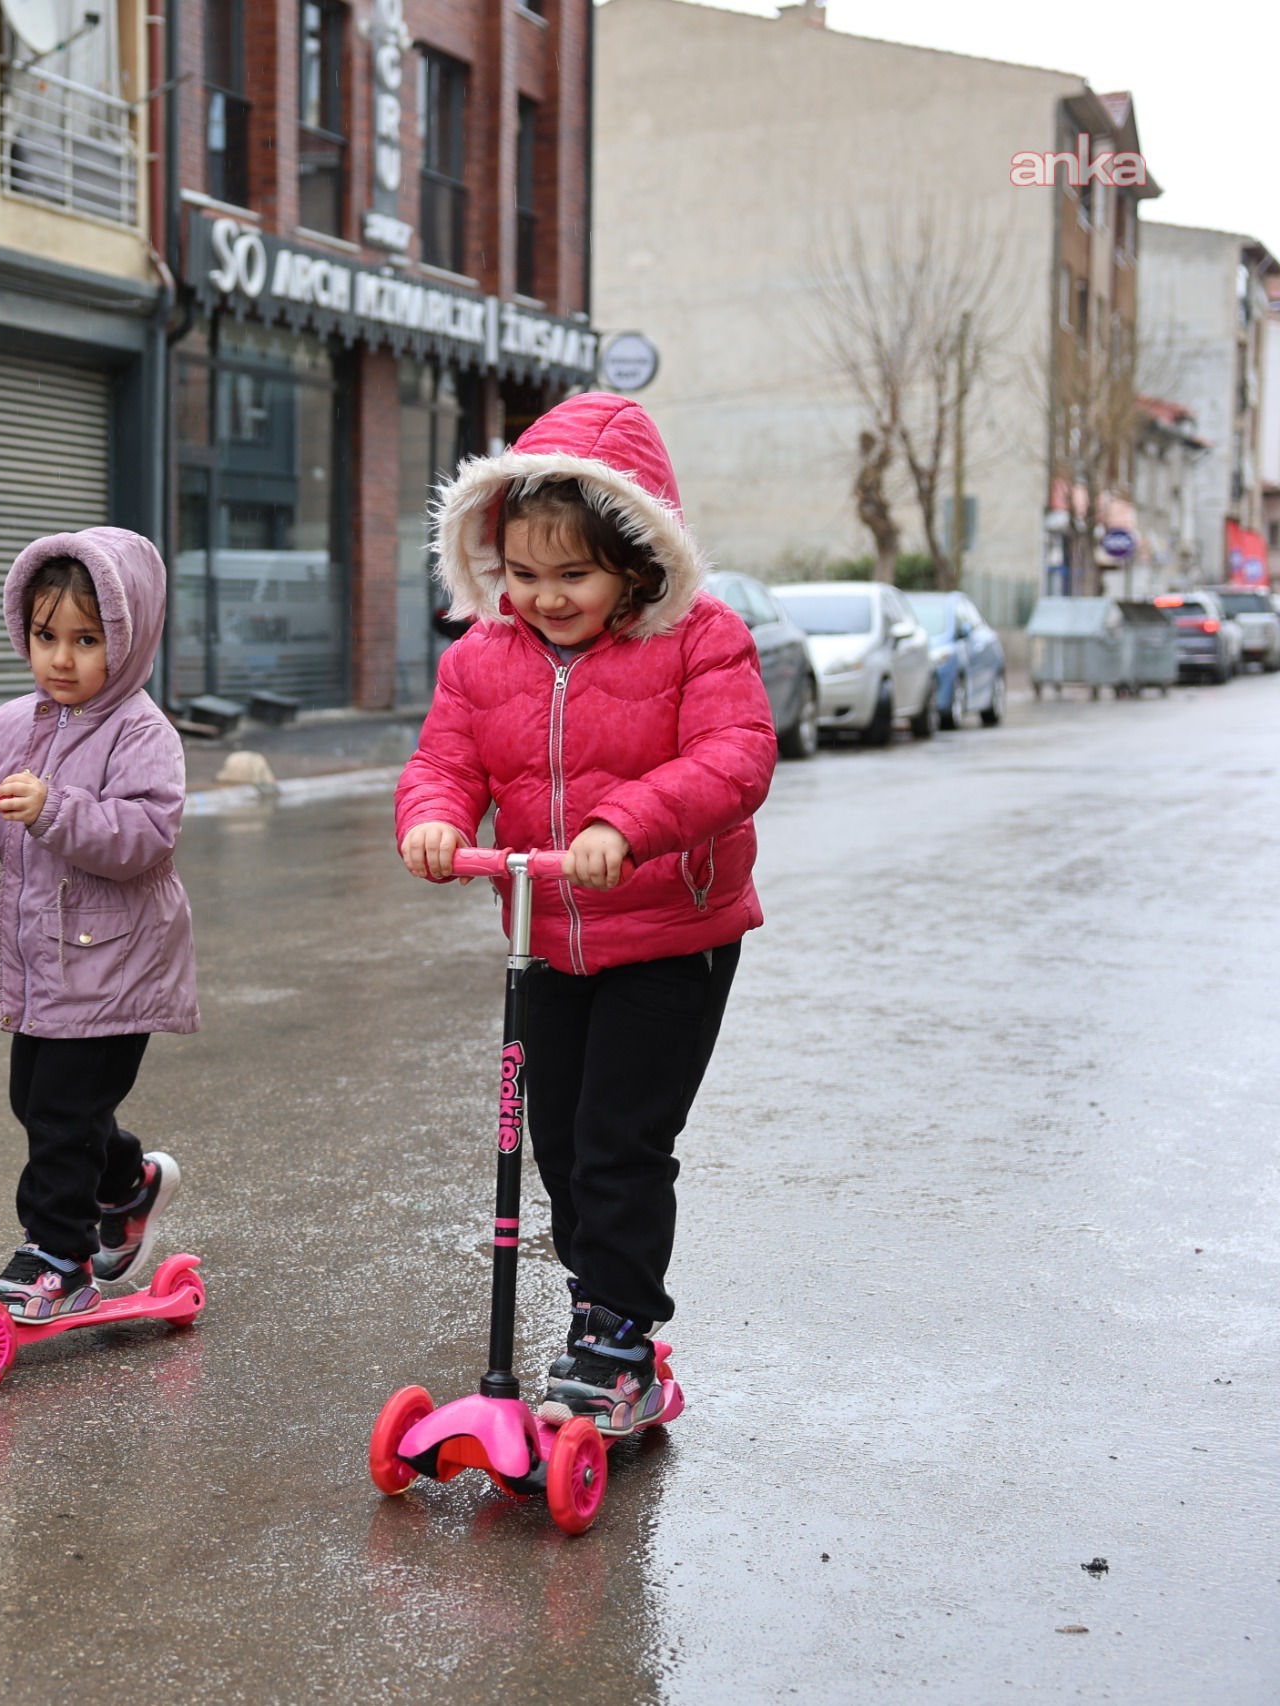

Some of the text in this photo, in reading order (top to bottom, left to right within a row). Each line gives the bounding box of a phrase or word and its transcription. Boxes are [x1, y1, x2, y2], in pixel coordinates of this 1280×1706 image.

[271, 249, 352, 313] ARCH
[499, 302, 599, 371] İNŞAAT
[498, 1040, 526, 1154] rookie
